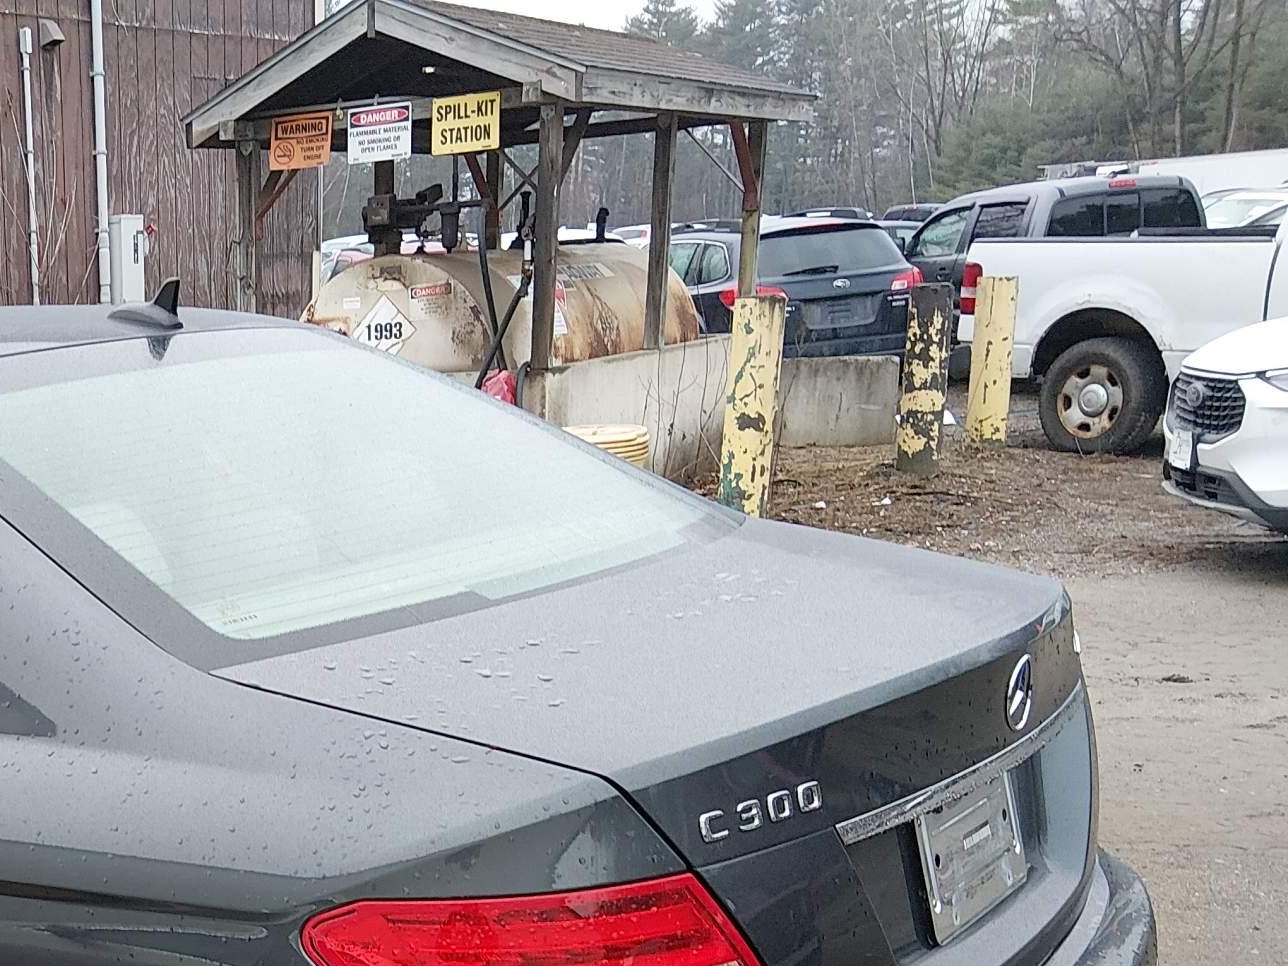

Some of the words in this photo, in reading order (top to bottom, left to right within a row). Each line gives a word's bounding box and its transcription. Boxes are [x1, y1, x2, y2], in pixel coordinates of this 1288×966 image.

[360, 110, 399, 124] DANGER
[436, 99, 496, 122] SPILL-KIT
[281, 121, 324, 136] WARNING
[349, 128, 382, 138] FLAMMABLE
[383, 125, 409, 133] MATERIAL
[440, 123, 491, 145] STATION
[367, 136, 392, 145] SMOKING
[377, 144, 398, 152] FLAMES
[304, 153, 322, 161] ENGINE
[366, 321, 403, 341] 1993
[698, 809, 730, 844] C
[736, 780, 823, 832] 300
